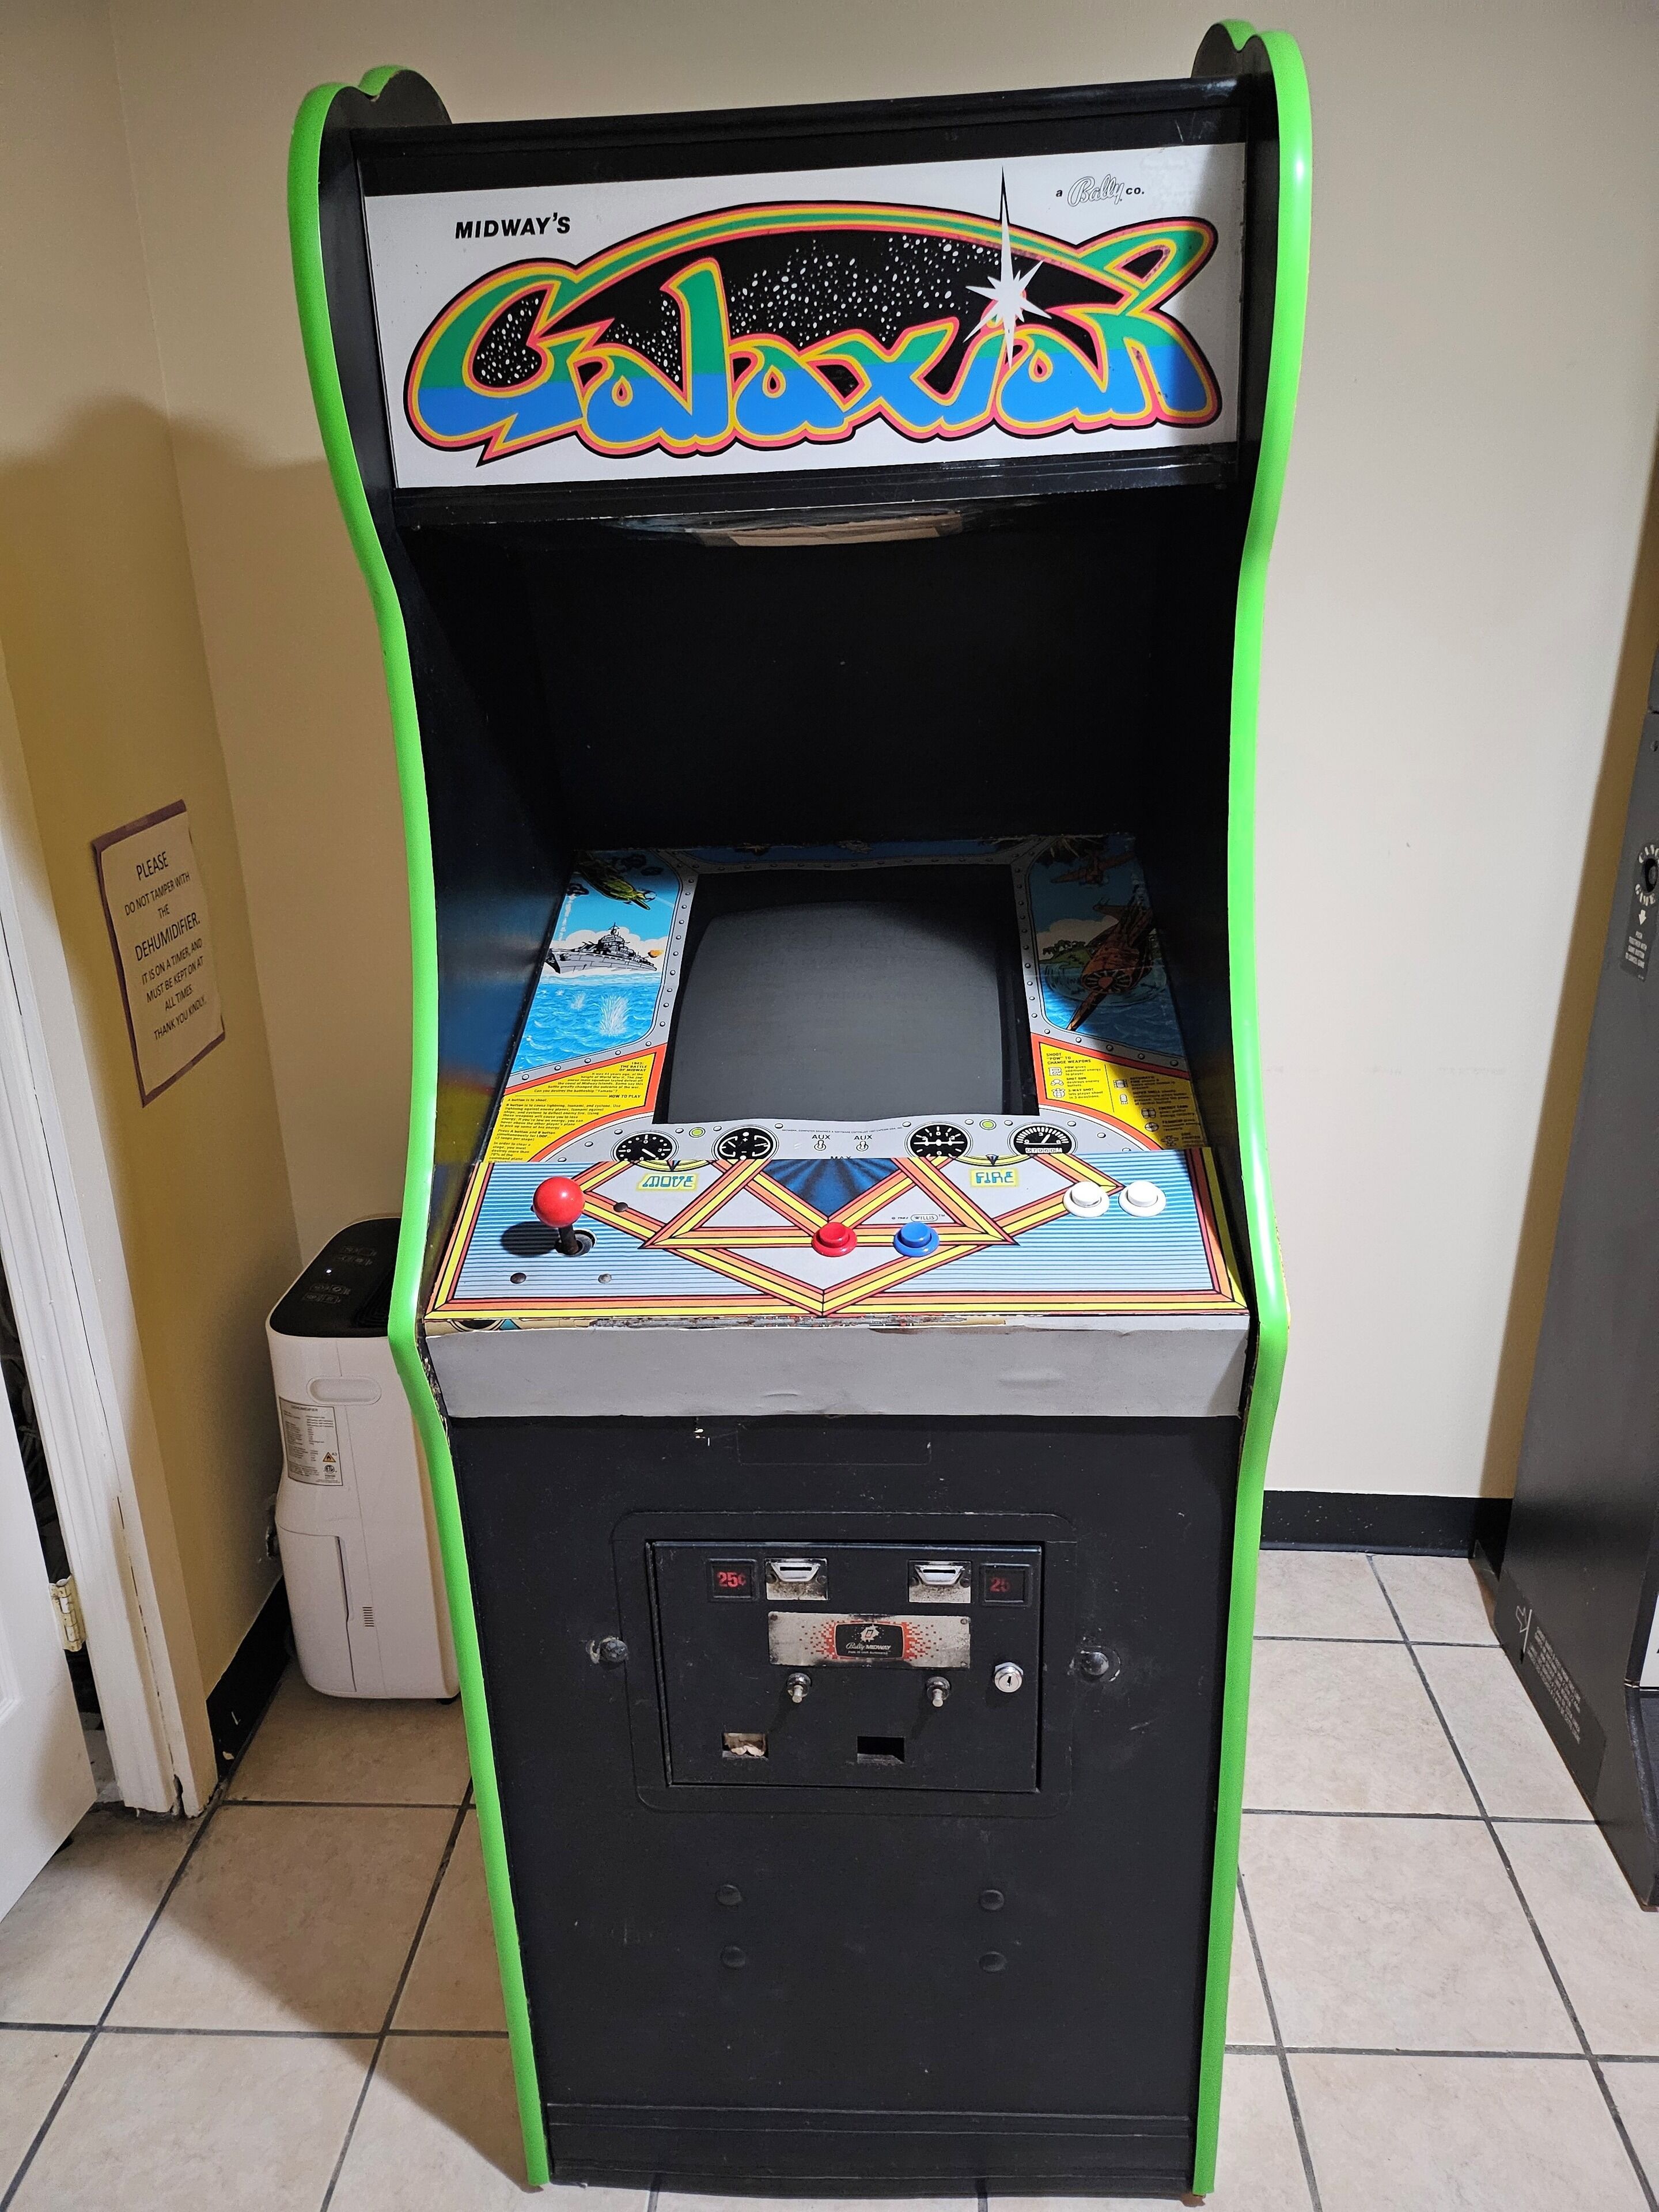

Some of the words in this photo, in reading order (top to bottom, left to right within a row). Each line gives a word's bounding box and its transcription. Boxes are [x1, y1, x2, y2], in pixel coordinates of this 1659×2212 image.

[1067, 174, 1124, 207] Bally
[455, 212, 570, 239] MIDWAY'S
[404, 200, 1221, 468] Galaxian
[136, 851, 169, 881] PLEASE
[124, 902, 135, 916] DO
[136, 893, 150, 909] NOT
[150, 880, 175, 901] TAMPER
[174, 871, 190, 887] WITH
[157, 904, 170, 919] THE
[135, 912, 200, 961] DEHUMIDIFIER.
[141, 972, 147, 985] IT
[149, 969, 155, 980] IS
[155, 962, 165, 976] ON
[166, 959, 172, 970] A
[191, 938, 203, 954] AND
[146, 983, 164, 1003] MUST
[165, 978, 173, 991] BE
[173, 968, 187, 985] KEPT
[188, 962, 196, 975] ON
[197, 956, 203, 968] AT
[165, 997, 176, 1012] ALL
[154, 1018, 176, 1040] THANK
[176, 1009, 189, 1025] YOU
[642, 1176, 694, 1187] MOVE
[976, 1172, 1014, 1183] FIRE
[846, 1642, 865, 1651] Bally
